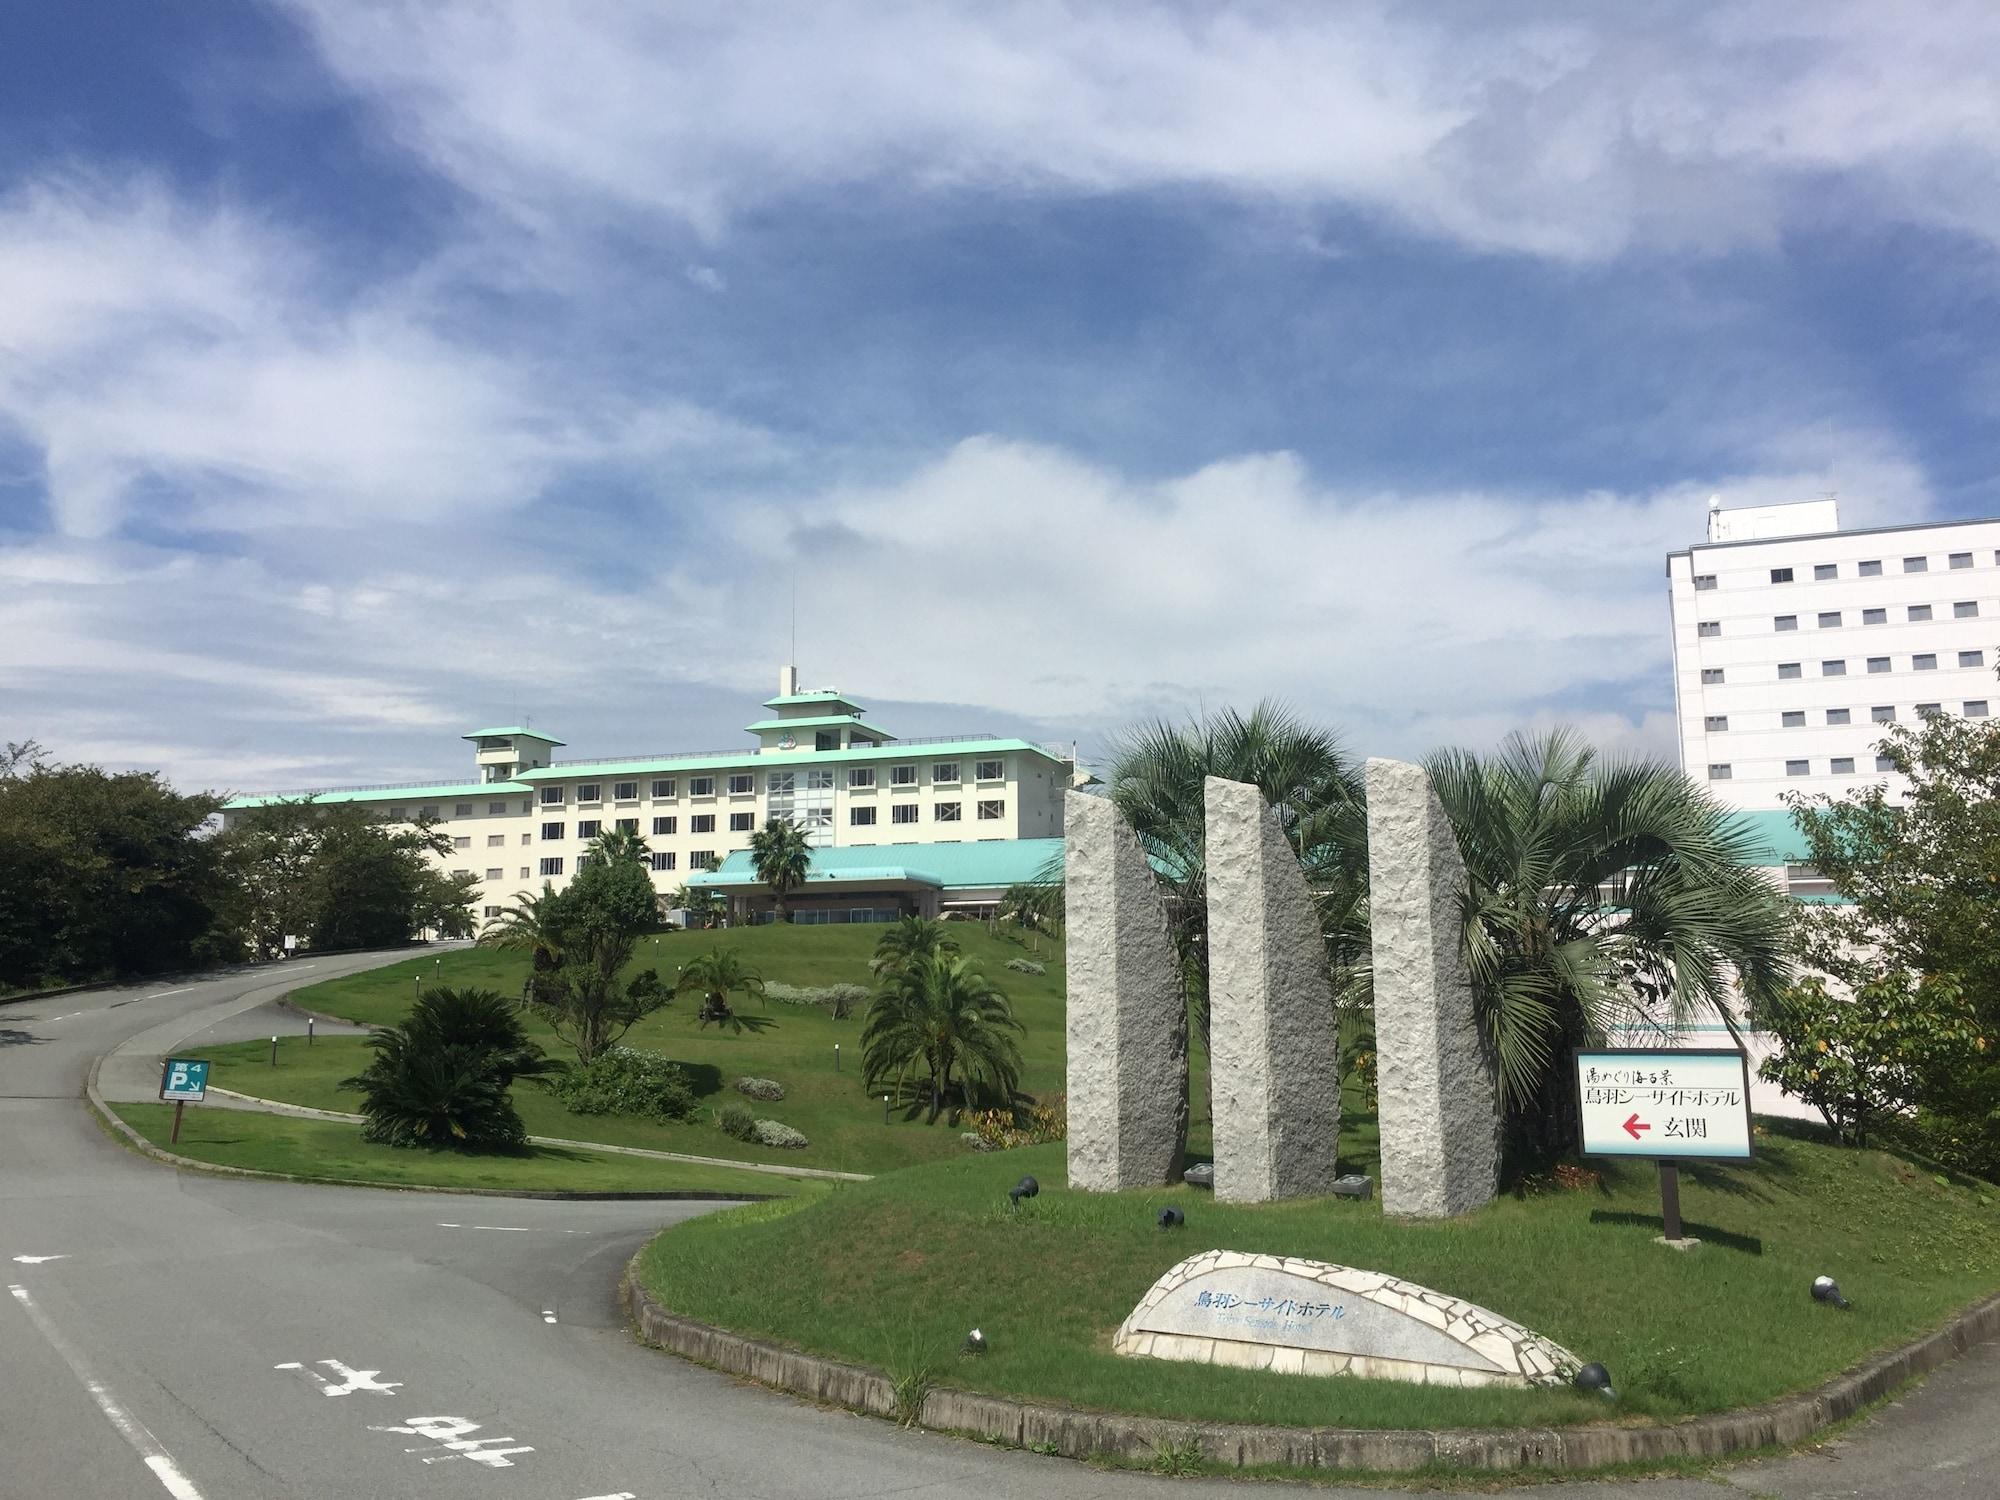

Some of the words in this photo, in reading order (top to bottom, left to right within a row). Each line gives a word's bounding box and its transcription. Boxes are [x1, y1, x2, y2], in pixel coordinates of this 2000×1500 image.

[169, 1071, 188, 1090] P
[1585, 1088, 1741, 1107] 鳥羽シーサイドホテル
[1663, 1116, 1707, 1139] 玄関
[1194, 1290, 1347, 1320] 鳥羽シーサイドホテル
